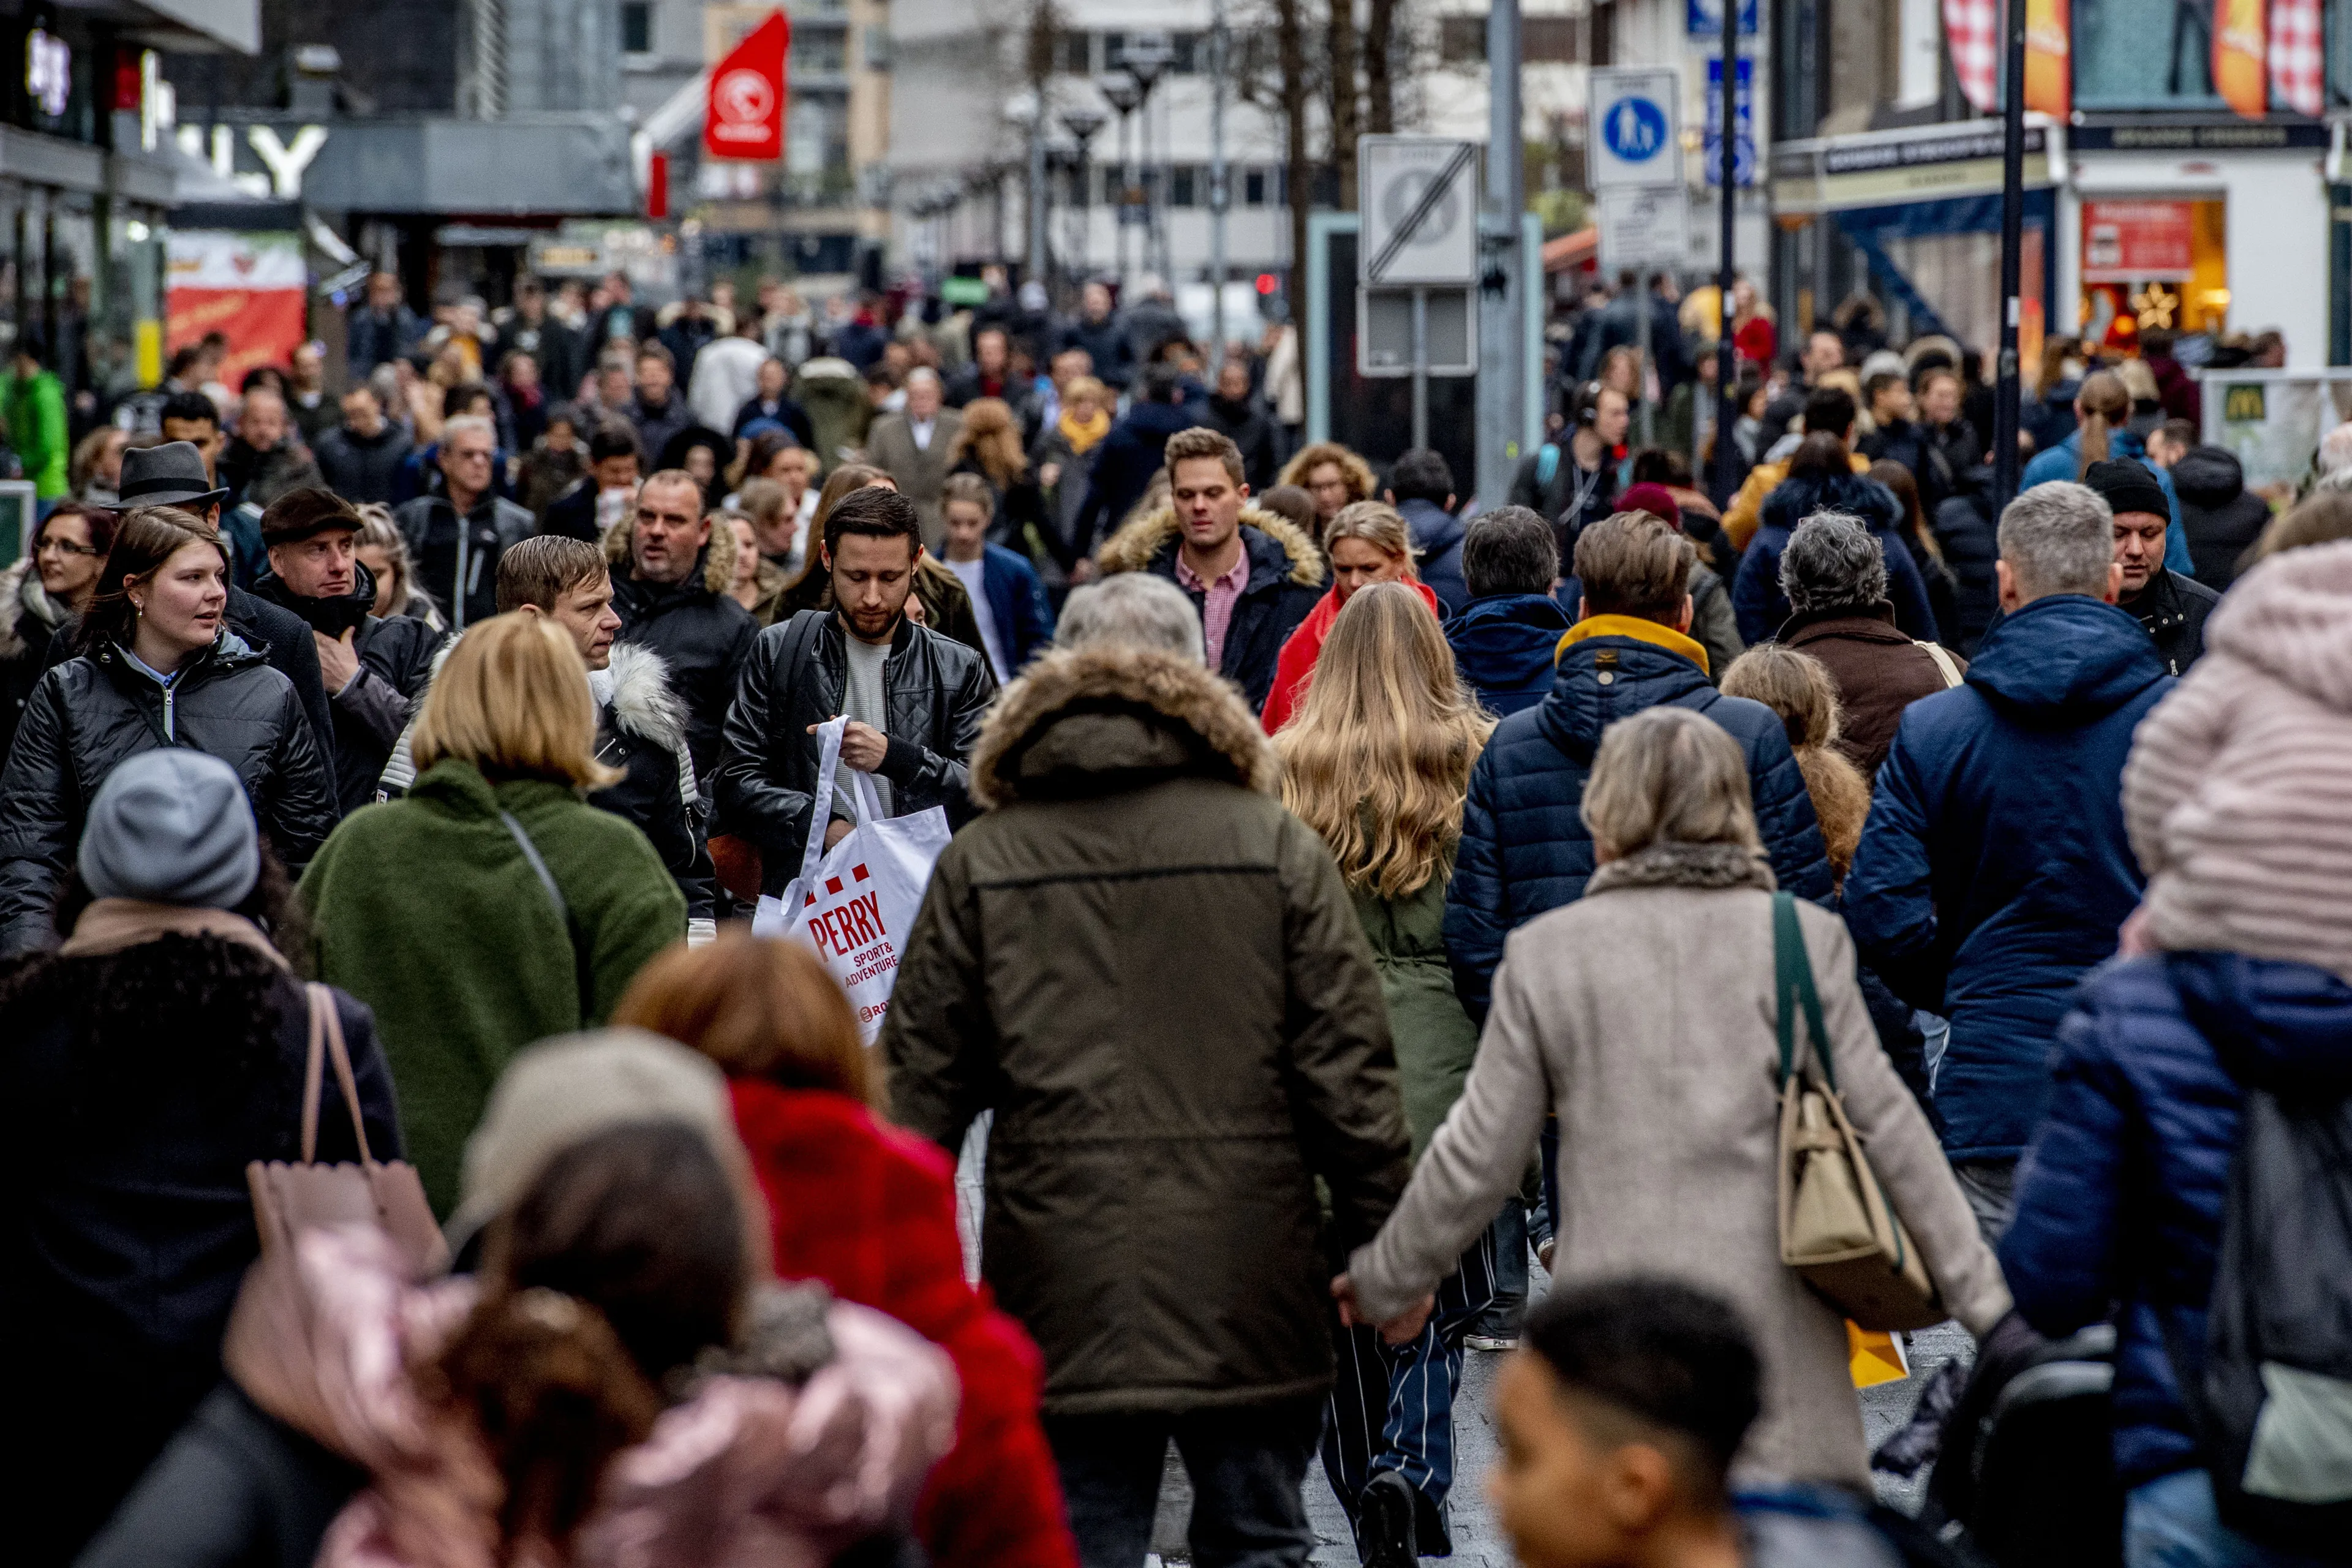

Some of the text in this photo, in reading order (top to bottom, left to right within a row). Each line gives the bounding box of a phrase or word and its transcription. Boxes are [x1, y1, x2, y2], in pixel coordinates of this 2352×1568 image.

[808, 890, 886, 963] PERRY
[845, 954, 899, 988] ADVENTURE
[872, 999, 890, 1016] RO
